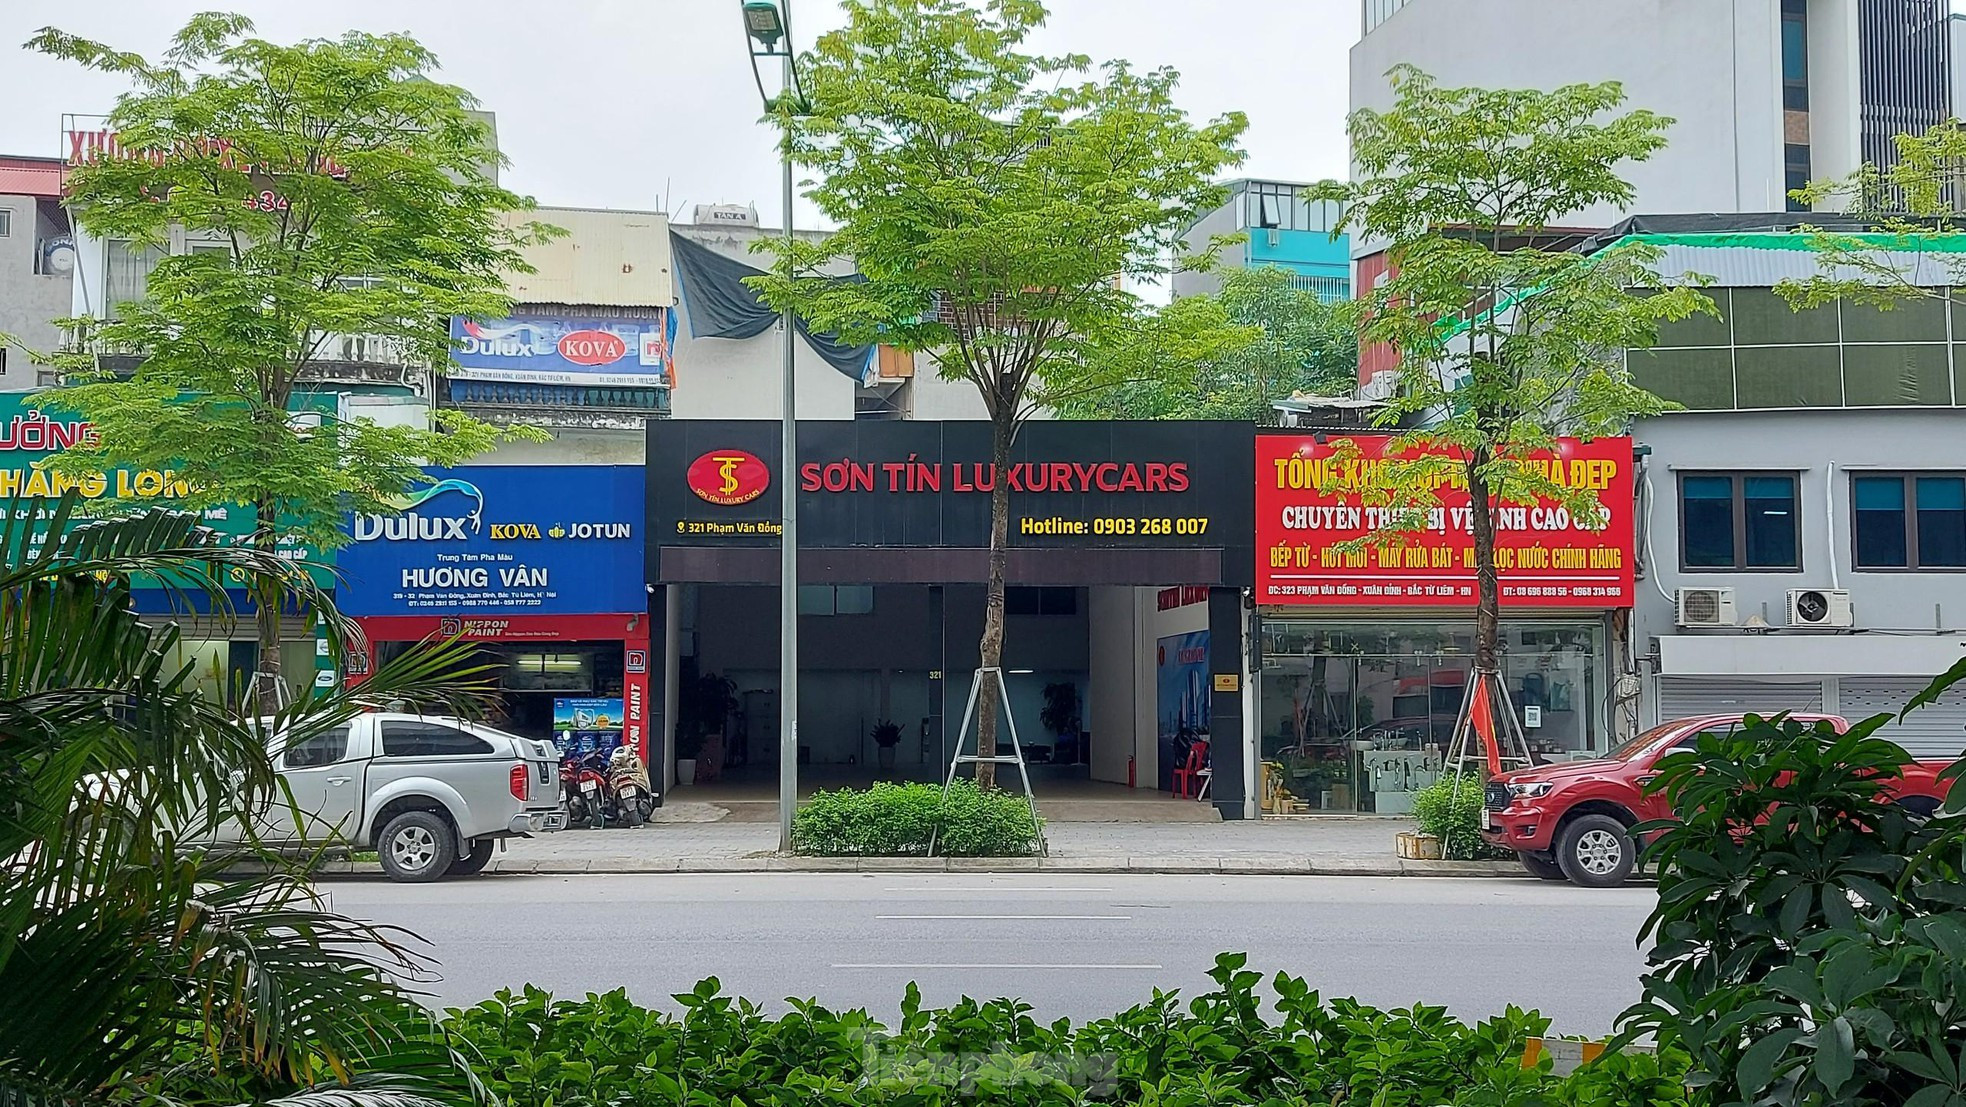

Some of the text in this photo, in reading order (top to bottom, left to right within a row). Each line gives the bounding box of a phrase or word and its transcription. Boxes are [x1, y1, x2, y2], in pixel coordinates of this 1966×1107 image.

[459, 336, 533, 357] Dulux
[565, 340, 619, 357] KOVA
[800, 453, 1190, 492] SƠN TÍN LUXURYCARS
[1282, 500, 1362, 530] CHUYÊN
[1530, 507, 1569, 531] CAO
[354, 510, 468, 541] Dulux
[490, 523, 542, 539] KOVA
[568, 523, 631, 539] JOTUN
[688, 520, 783, 535] 321 Phạm Văn Đồng
[1020, 517, 1208, 535] Hotline: 0903 268 007
[437, 553, 460, 562] Trung
[480, 553, 495, 561] Pha
[1270, 540, 1292, 567] BẾP
[1294, 541, 1311, 567] TỪ
[1405, 539, 1429, 568] RỬA
[1431, 542, 1453, 568] BÁT
[1517, 541, 1549, 569] NƯỚC
[1552, 543, 1587, 569] CHÍNH
[1590, 544, 1622, 569] HÃNG
[402, 564, 548, 588] HƯƠNG VÂN
[1281, 586, 1296, 595] 323
[1460, 586, 1472, 596] HN
[467, 628, 503, 636] PAINT
[929, 670, 942, 680] 321
[630, 683, 641, 720] PAINT
